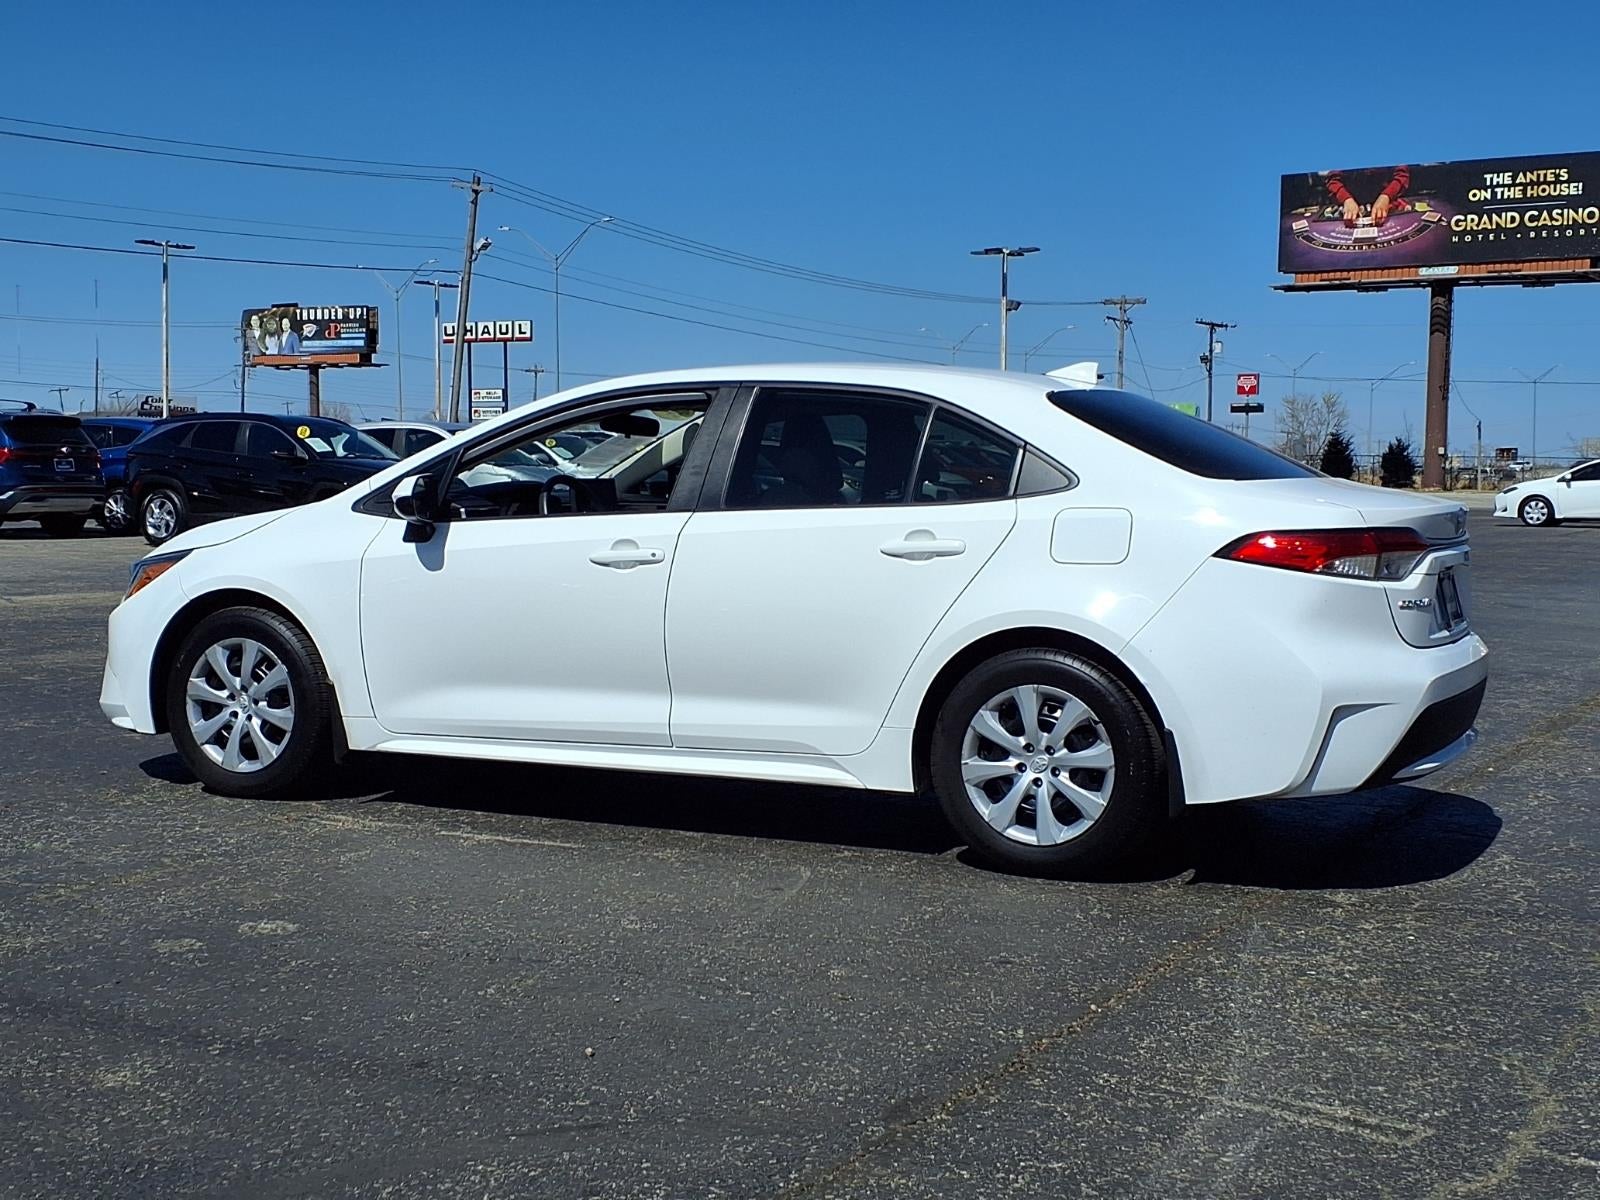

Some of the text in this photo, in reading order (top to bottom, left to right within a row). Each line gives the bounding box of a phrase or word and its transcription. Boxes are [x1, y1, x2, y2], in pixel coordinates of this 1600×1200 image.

[1483, 168, 1569, 186] THE ANTE'S
[1468, 182, 1583, 202] ON THE HOUSE!
[1450, 206, 1600, 232] GRAND CASINO
[1452, 227, 1598, 243] HOTEL RESORT
[296, 307, 367, 321] THUNDER UP!
